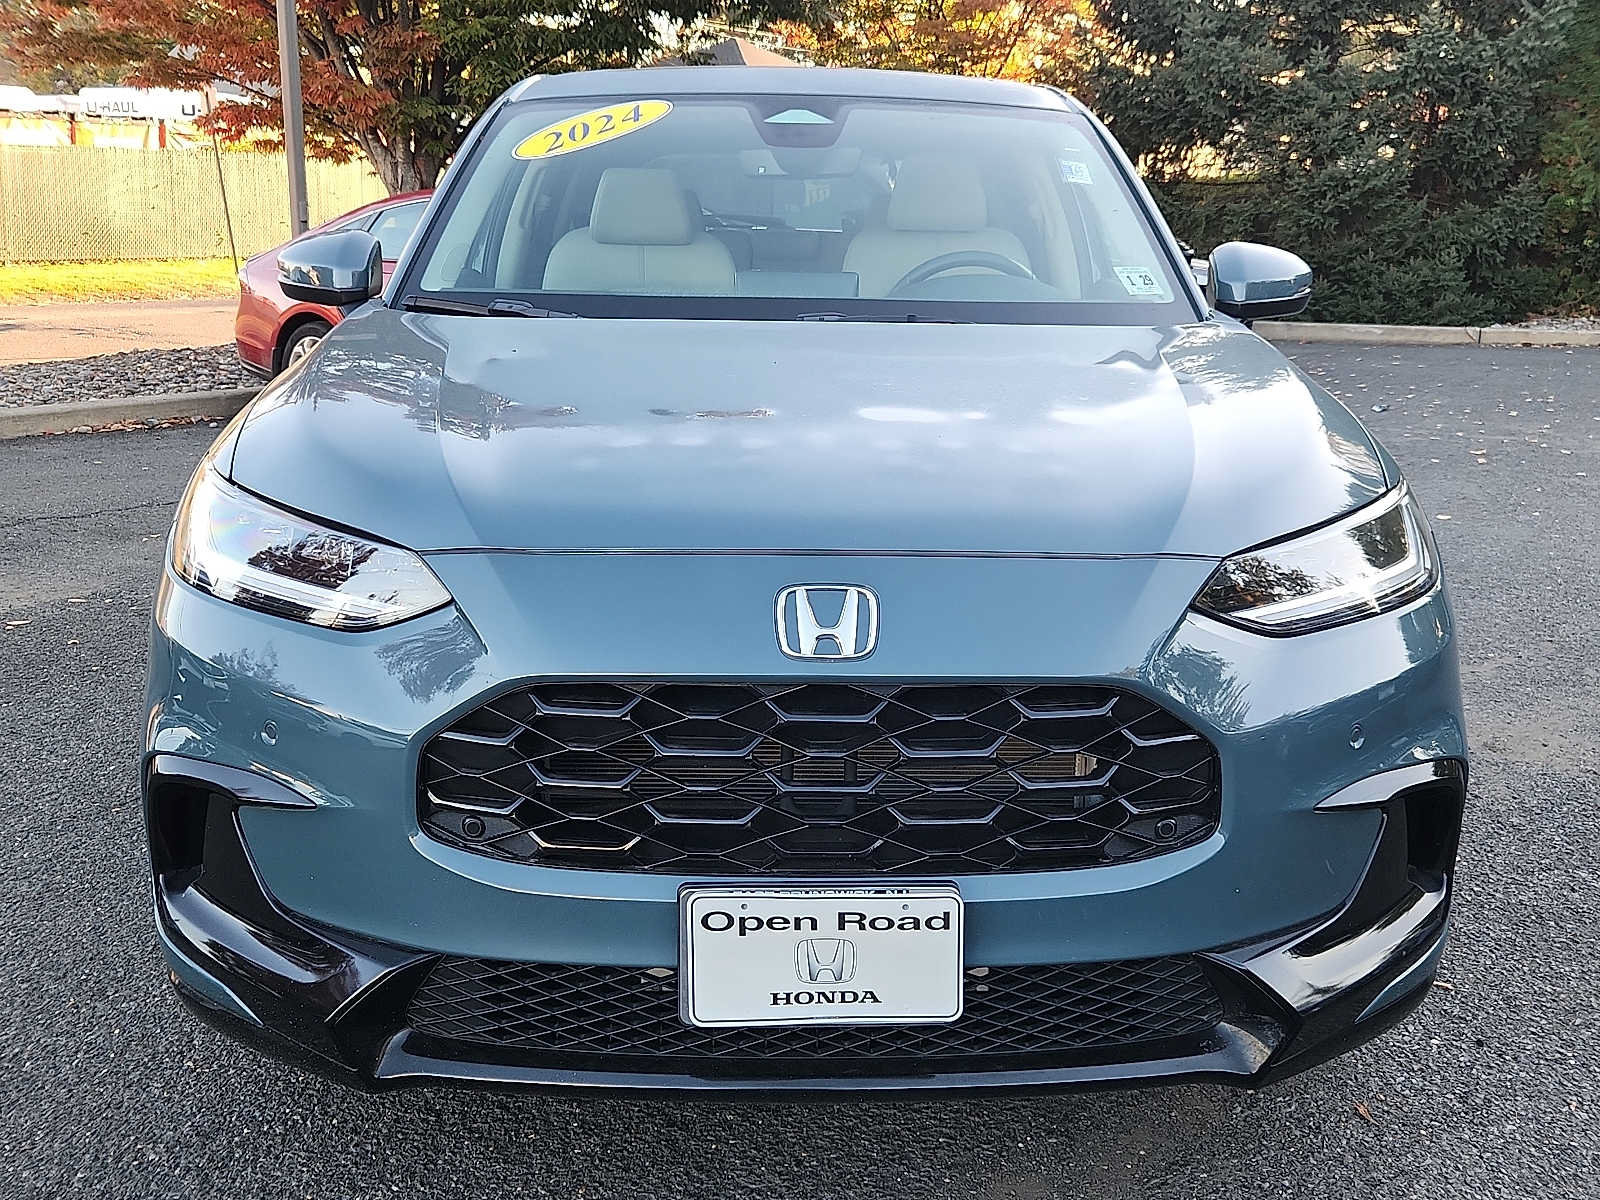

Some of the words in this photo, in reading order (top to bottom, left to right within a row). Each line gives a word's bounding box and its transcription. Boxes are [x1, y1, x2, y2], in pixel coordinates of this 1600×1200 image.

[86, 101, 139, 113] U-HAUL
[543, 104, 643, 153] 2024
[1139, 274, 1154, 286] 29
[700, 911, 818, 937] Open
[837, 911, 951, 931] Road
[769, 990, 882, 1006] HONDA
